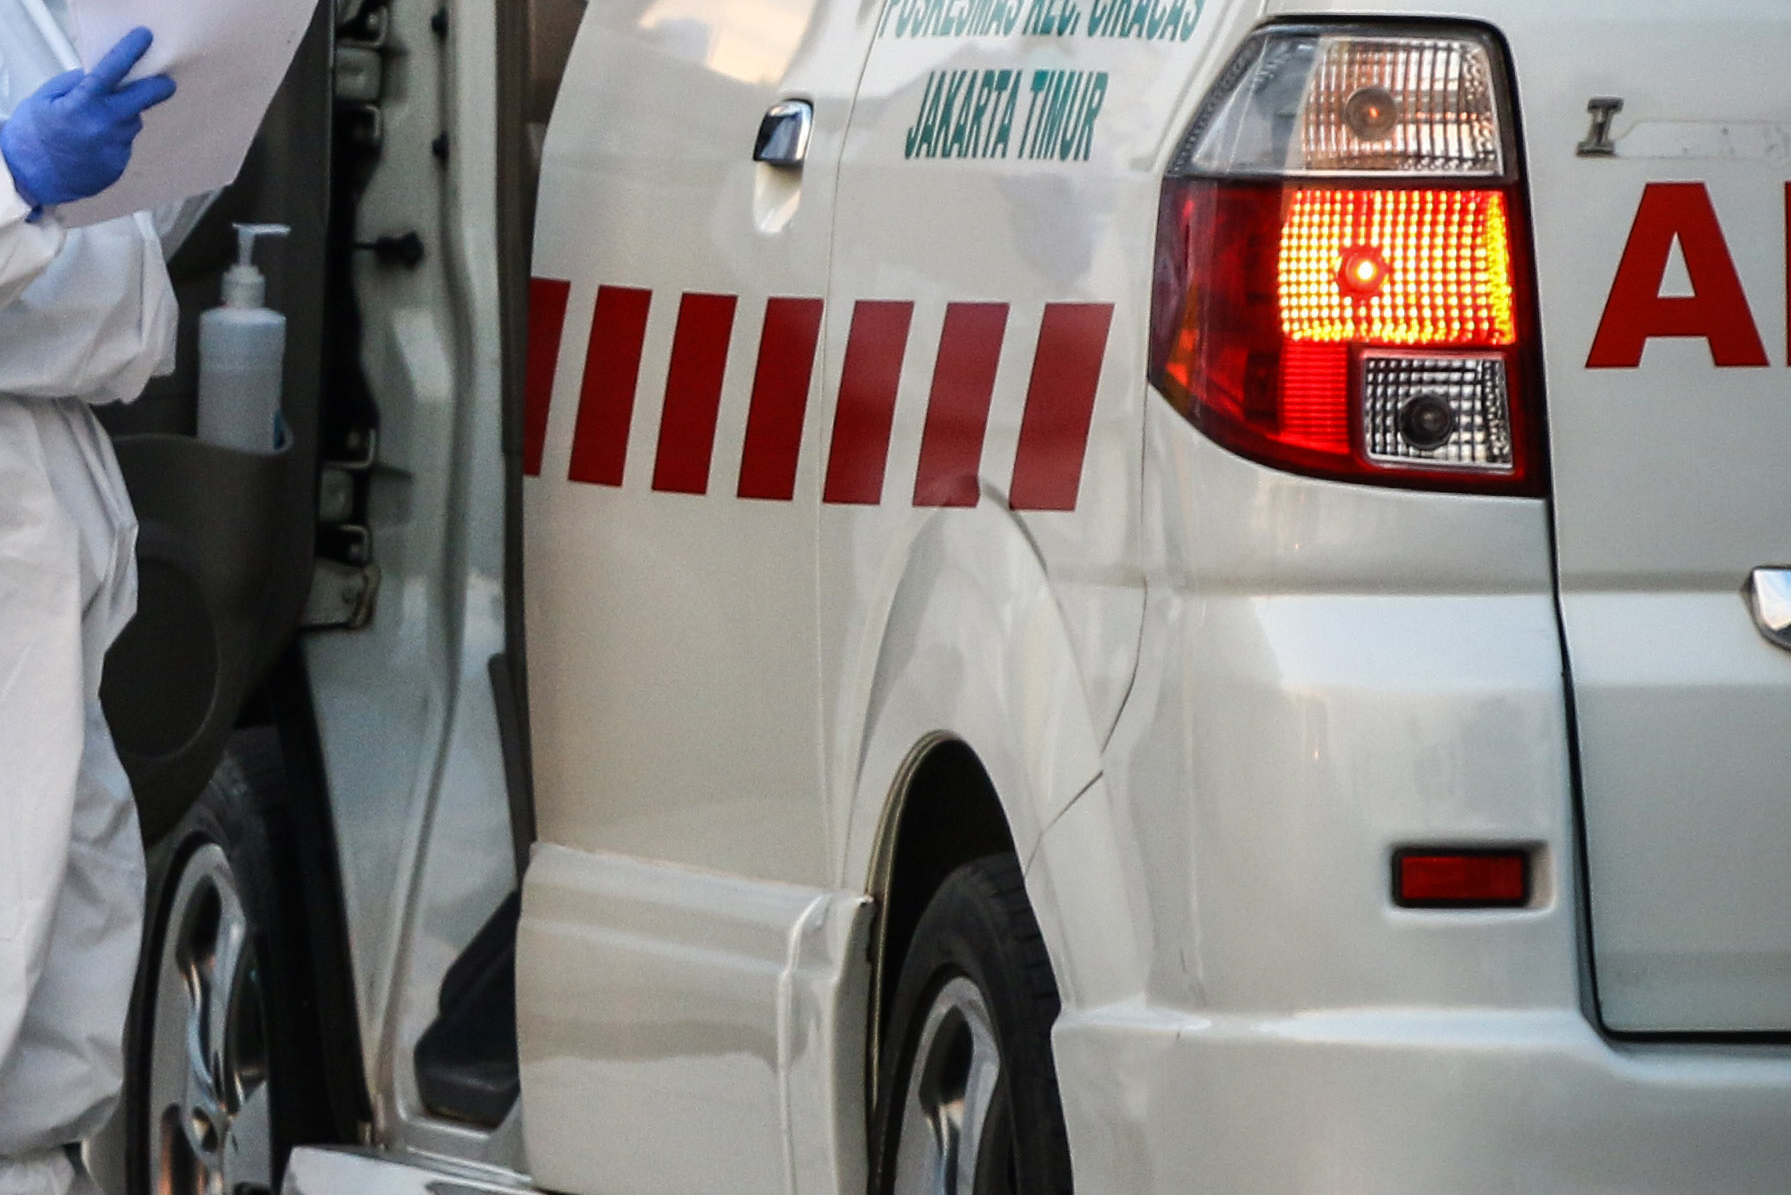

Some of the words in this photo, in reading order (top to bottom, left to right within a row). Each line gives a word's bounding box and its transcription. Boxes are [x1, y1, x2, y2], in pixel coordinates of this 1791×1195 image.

[905, 68, 1023, 160] JAKARTA
[1018, 68, 1110, 161] TIMUR
[1584, 180, 1791, 369] A
